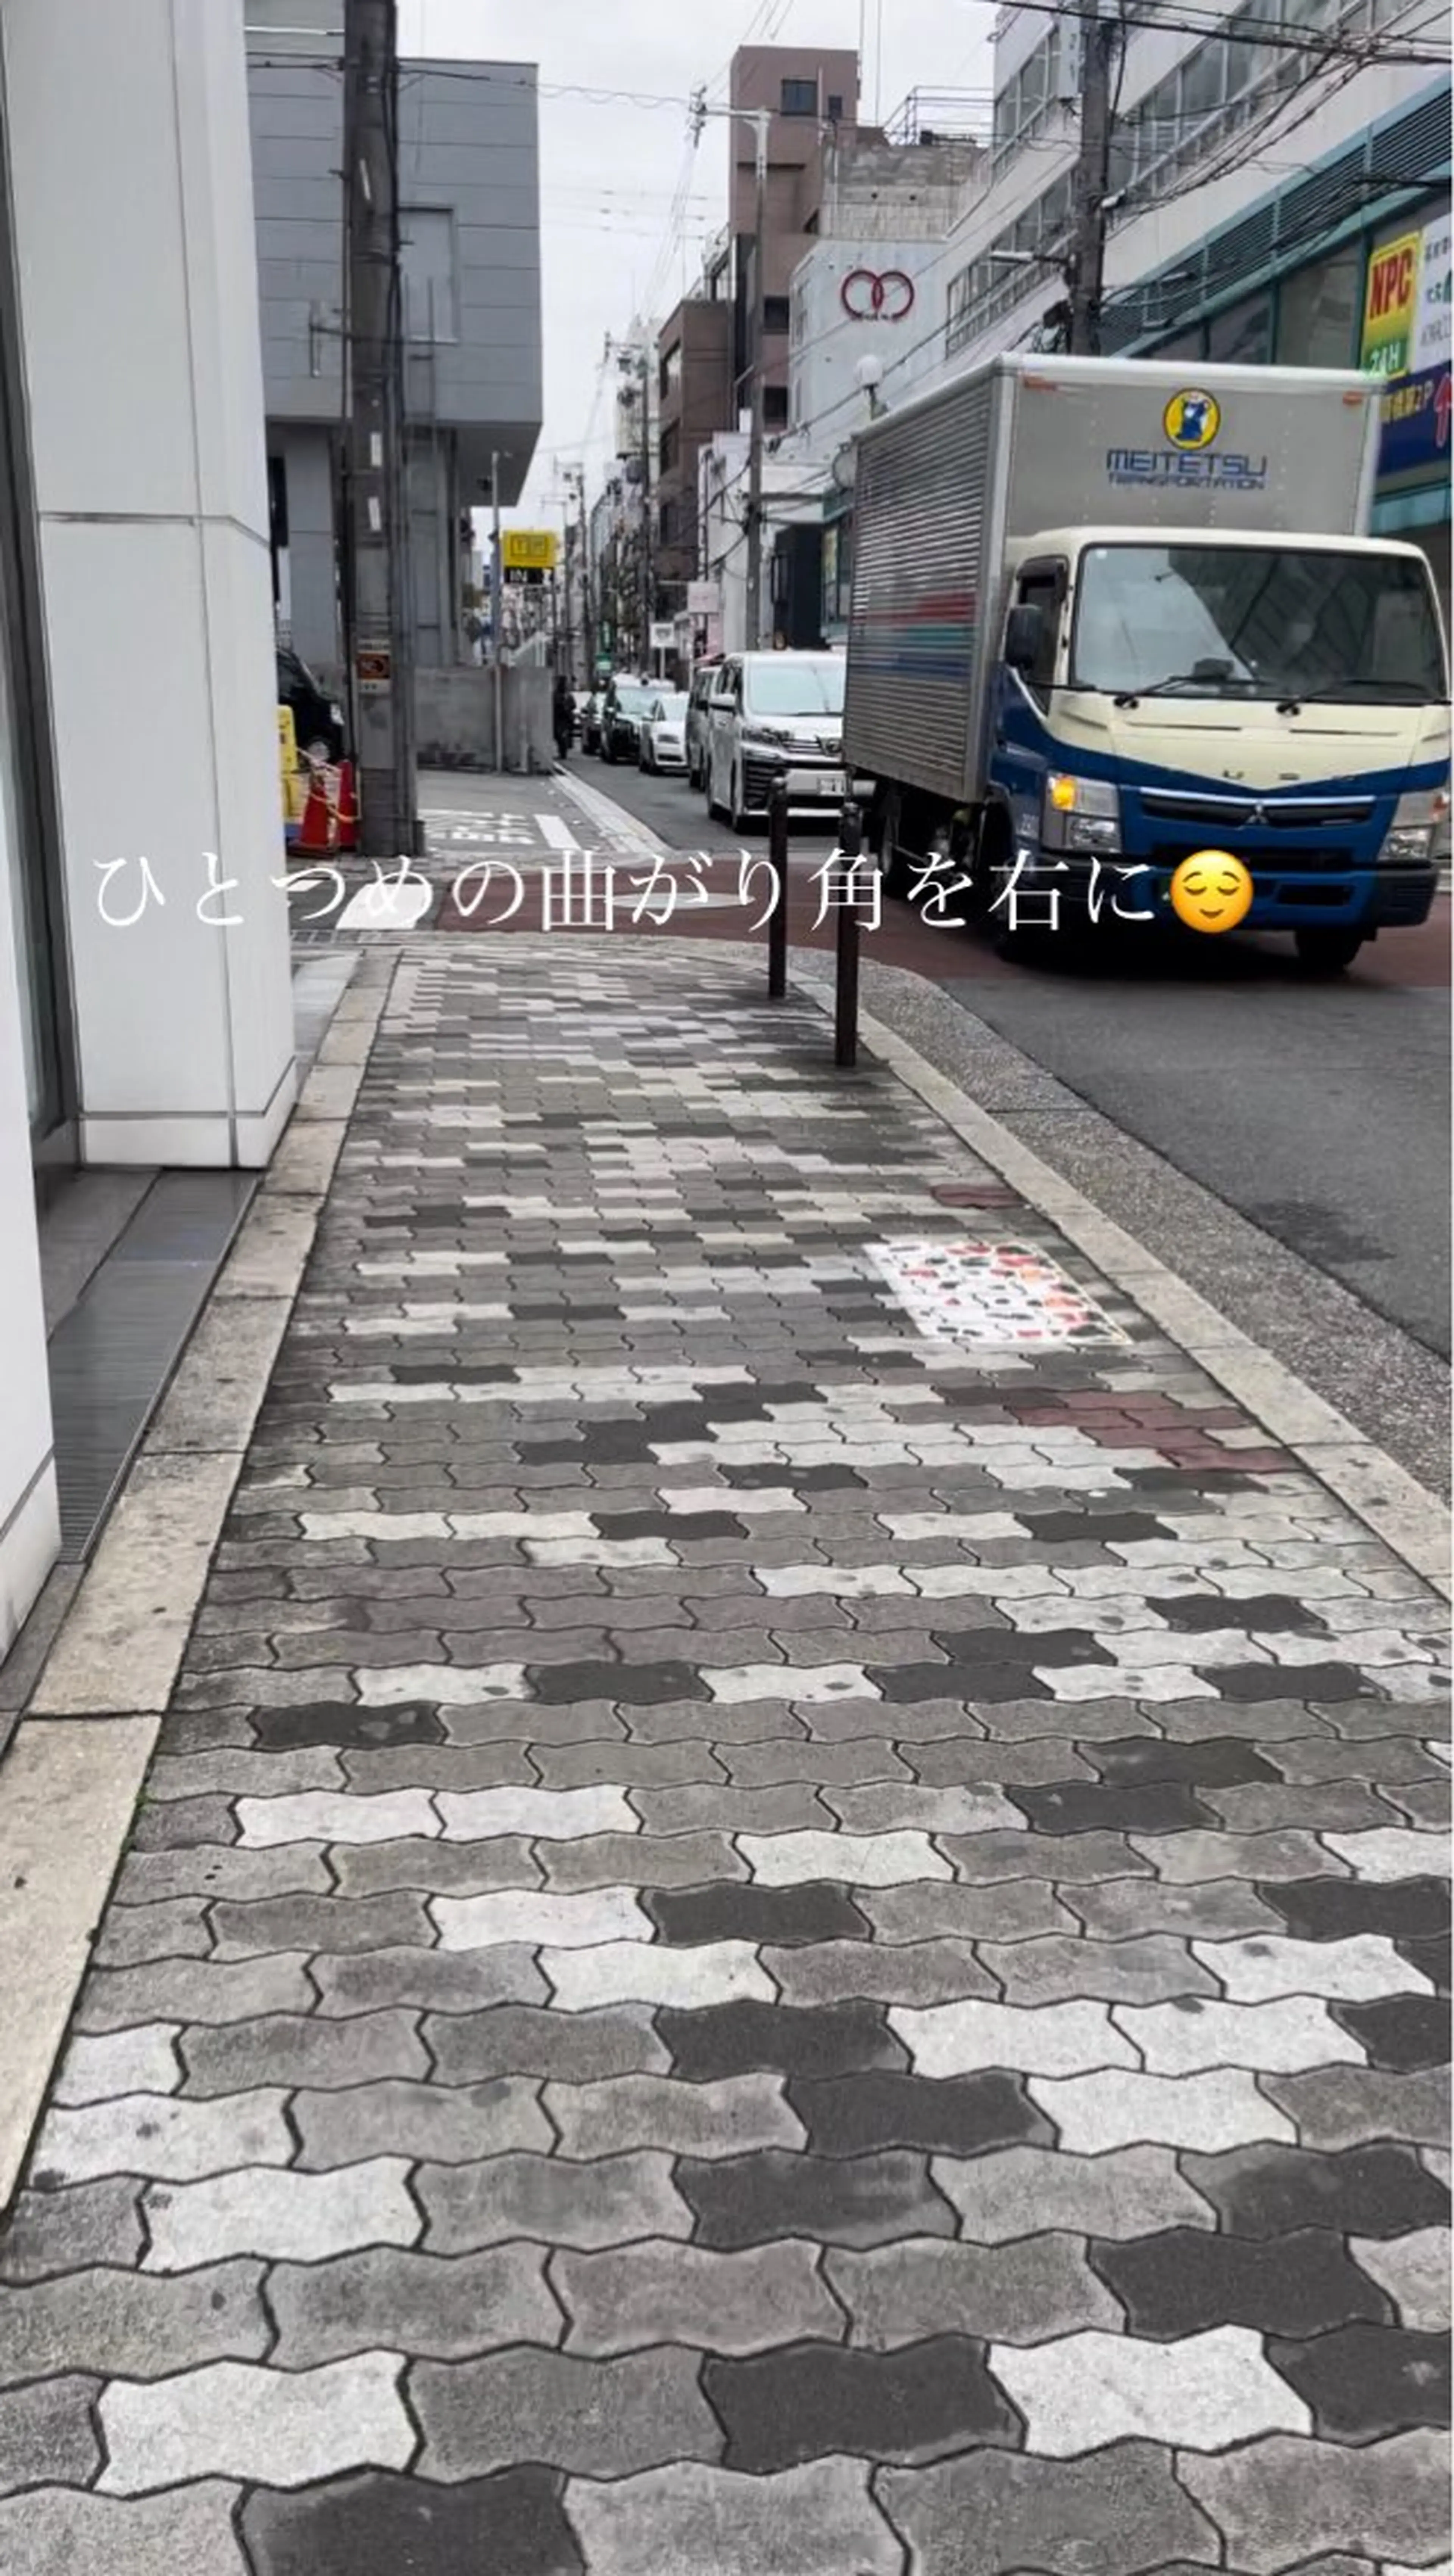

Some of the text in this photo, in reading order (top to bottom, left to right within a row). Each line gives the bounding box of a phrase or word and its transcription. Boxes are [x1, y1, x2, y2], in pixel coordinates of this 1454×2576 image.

[1368, 247, 1414, 321] NPC
[1369, 340, 1401, 377] 24H
[1106, 447, 1268, 476] MEITETSU
[1109, 472, 1266, 490] TRANSPORTATION
